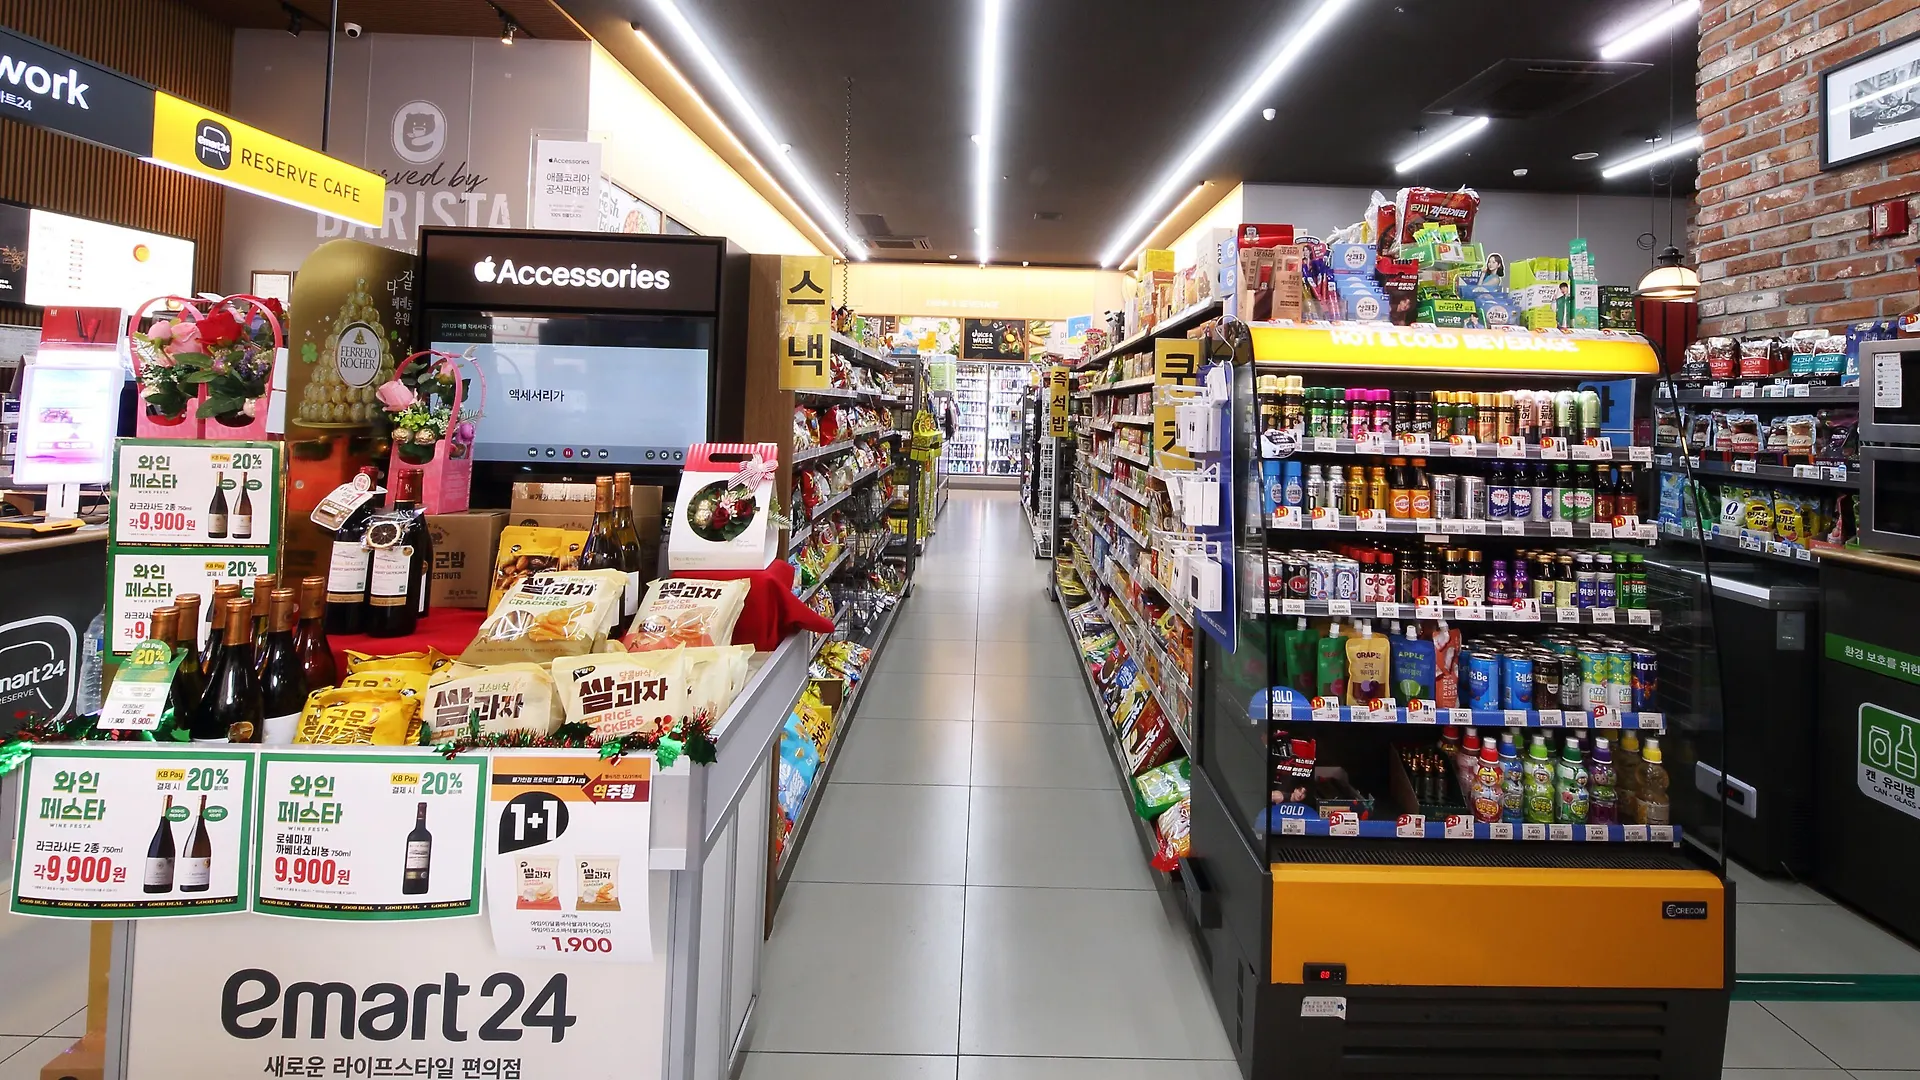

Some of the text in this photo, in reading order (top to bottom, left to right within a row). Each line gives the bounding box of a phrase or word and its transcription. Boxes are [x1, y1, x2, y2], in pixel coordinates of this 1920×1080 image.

[0, 55, 90, 110] work
[242, 148, 361, 203] RESERVE CAFE
[546, 172, 590, 183] 애플코리아
[546, 184, 590, 196] 공식판매점
[316, 189, 511, 240] RISTA
[498, 258, 670, 290] Accessories
[786, 269, 826, 377] 스낵
[1332, 331, 1580, 353] HOT COLD BEVERAGE
[340, 346, 377, 359] FERRERO
[340, 358, 376, 370] ROCHER
[509, 388, 565, 402] 액세서리가
[1052, 370, 1067, 433] 즉석밥
[1403, 435, 1415, 443] 1+1
[1451, 436, 1463, 444] 1+1
[1500, 437, 1512, 445] 1+1
[1541, 438, 1553, 447] 1+1
[1585, 438, 1598, 447] 1+1
[138, 455, 170, 471] 와인
[130, 473, 178, 489] 페스타
[1515, 493, 1531, 501] 박카스
[165, 503, 176, 511] 2종
[1277, 507, 1288, 516] 1+1
[1314, 508, 1325, 517] 1+1
[1360, 510, 1372, 518] 1+1
[1614, 517, 1626, 526] 1+1
[435, 552, 466, 568] 군밤
[133, 563, 165, 580] 와인
[432, 572, 462, 580] ESTNUTS
[126, 582, 173, 598] 페스타
[659, 582, 722, 600] 쌀과자
[509, 599, 568, 607] CRACKERS
[135, 649, 165, 665] 20%
[1398, 651, 1424, 660] APPLE
[1845, 645, 1920, 677] 환경 보호를 위한
[619, 669, 652, 681] 달콤바삭
[0, 688, 35, 704] ESERVE
[579, 676, 668, 715] 쌀과자
[434, 688, 524, 727] 쌀과자
[1313, 698, 1324, 708] 1+1
[1370, 700, 1382, 709] 1+1
[1409, 701, 1421, 711] 1+1
[604, 709, 632, 721] RICE
[596, 715, 644, 734] ACKERS
[53, 770, 100, 793] 와인
[170, 771, 184, 780] Pay
[392, 774, 417, 784] KB Pay
[157, 783, 180, 791] 결제 시
[289, 774, 335, 798] 와인
[392, 786, 416, 794] 결제 시
[1865, 768, 1916, 800] 캔 유리병
[593, 783, 636, 799] 역주행
[1873, 785, 1917, 811] CAN GLASS
[40, 797, 106, 821] 페스타
[277, 801, 343, 825] 페스타
[1280, 804, 1305, 816] COLD
[511, 800, 558, 841] 1+1
[276, 833, 312, 845] 로쉐마제
[36, 840, 81, 853] 라크라사드
[84, 842, 100, 854] 2종
[274, 857, 350, 886] 9,900원
[523, 868, 551, 879] 쌀과자
[583, 868, 611, 879] 쌀과자
[1675, 906, 1706, 915] CRECOM
[221, 968, 577, 1043] emart24
[264, 1056, 522, 1080] 새로운 라이프스타일 편의점
